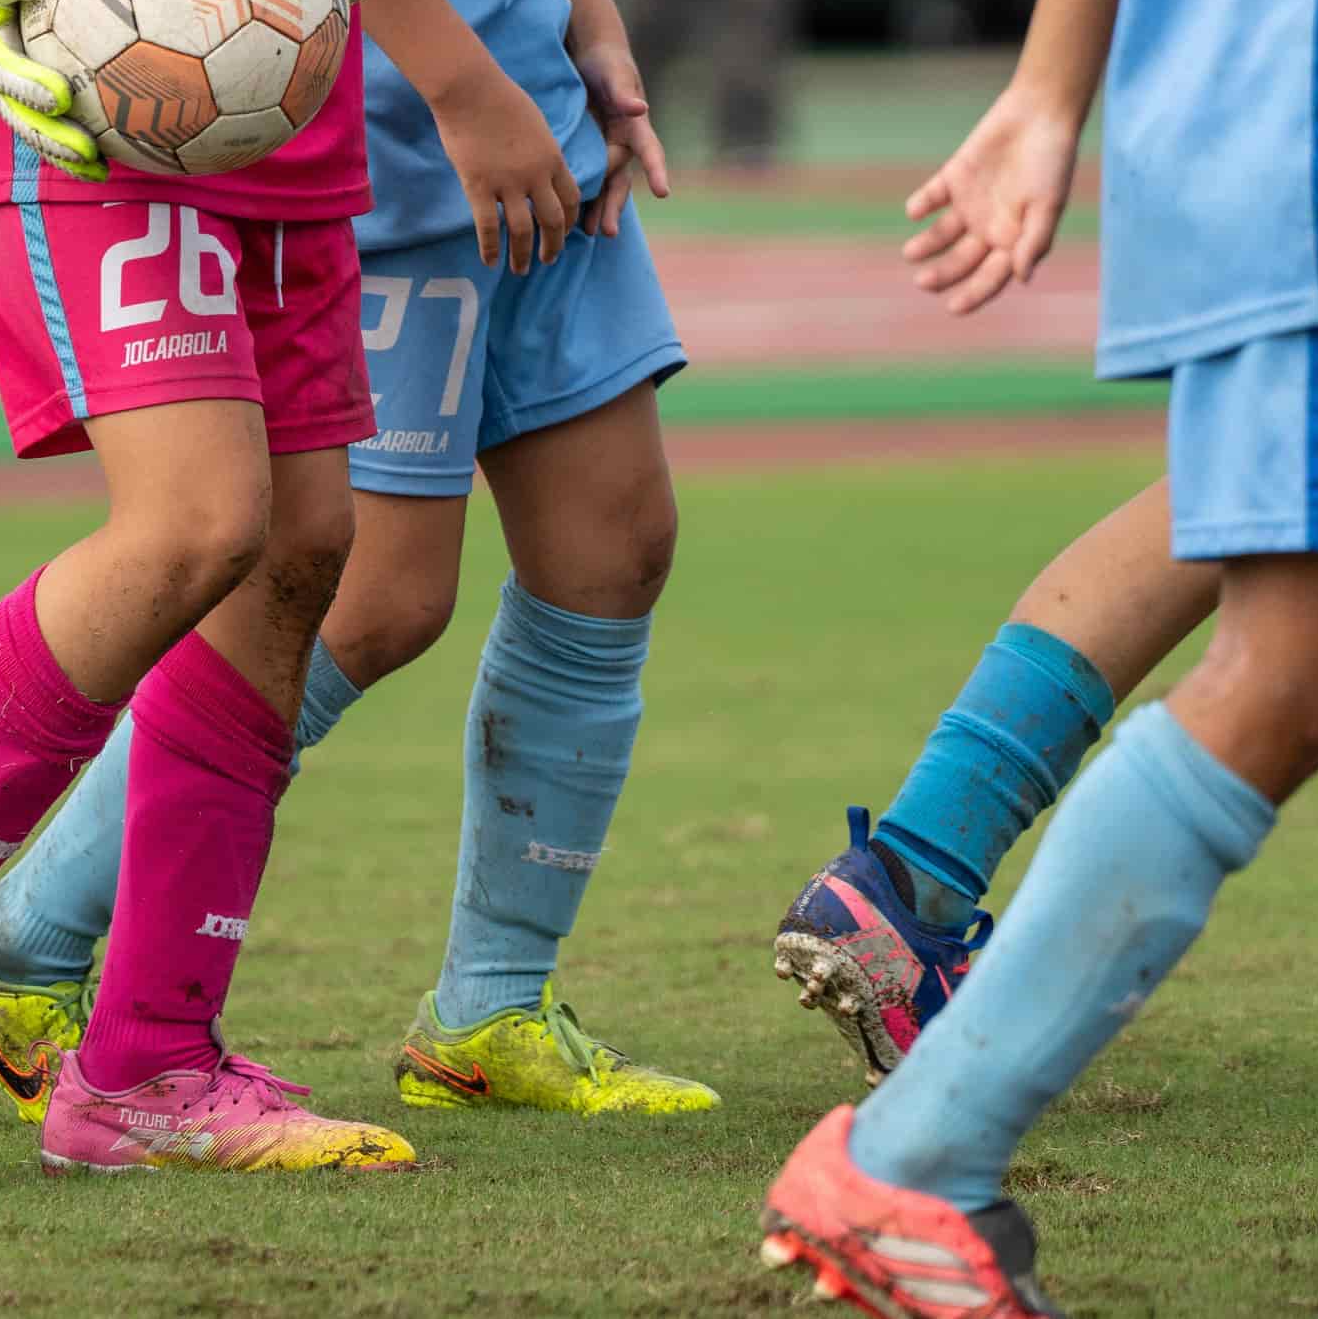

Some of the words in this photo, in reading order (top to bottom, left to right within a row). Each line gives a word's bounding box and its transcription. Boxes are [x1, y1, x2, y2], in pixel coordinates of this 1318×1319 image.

[100, 202, 238, 332] 26
[120, 330, 229, 369] JOGARBOLA
[119, 1105, 174, 1130] FUTURE
